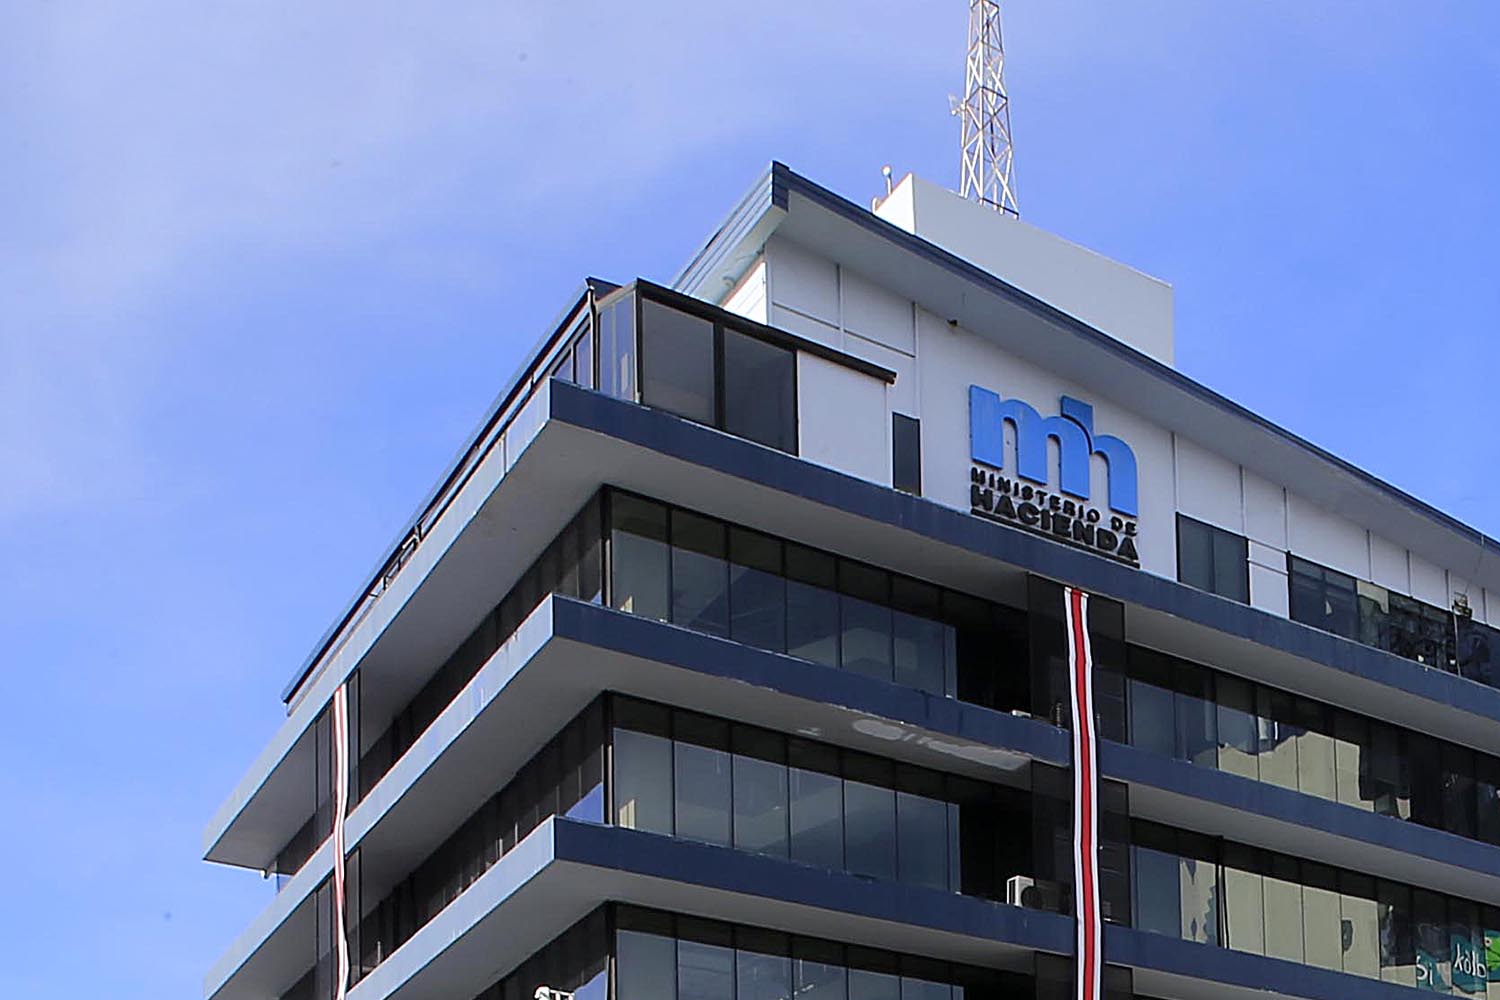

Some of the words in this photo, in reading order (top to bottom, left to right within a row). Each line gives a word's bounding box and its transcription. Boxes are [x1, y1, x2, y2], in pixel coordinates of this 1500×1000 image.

[970, 467, 1101, 523] MINISTERIO
[1111, 516, 1138, 537] DE
[970, 484, 1139, 561] HACIENDA
